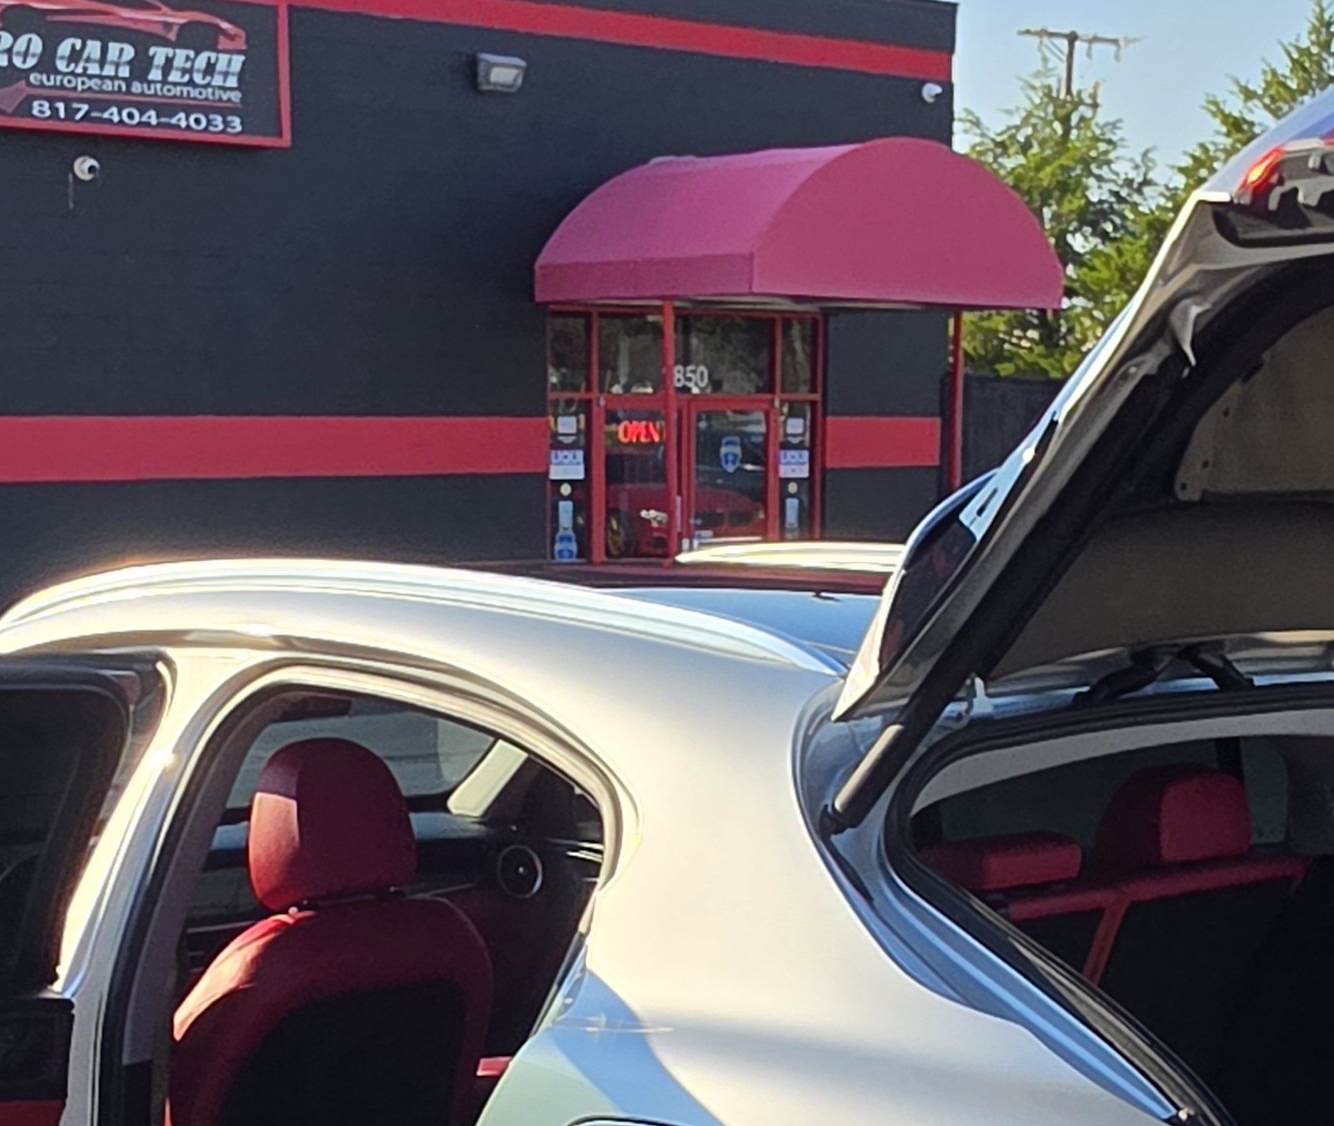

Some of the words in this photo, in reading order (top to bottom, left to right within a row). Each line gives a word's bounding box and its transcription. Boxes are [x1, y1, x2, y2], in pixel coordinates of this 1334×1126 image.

[55, 37, 136, 78] CAR
[147, 45, 246, 88] TECH
[29, 72, 126, 92] european
[130, 81, 243, 103] automotive
[31, 99, 243, 134] 817-404-4033
[663, 364, 709, 388] 850
[618, 420, 663, 443] OPEN
